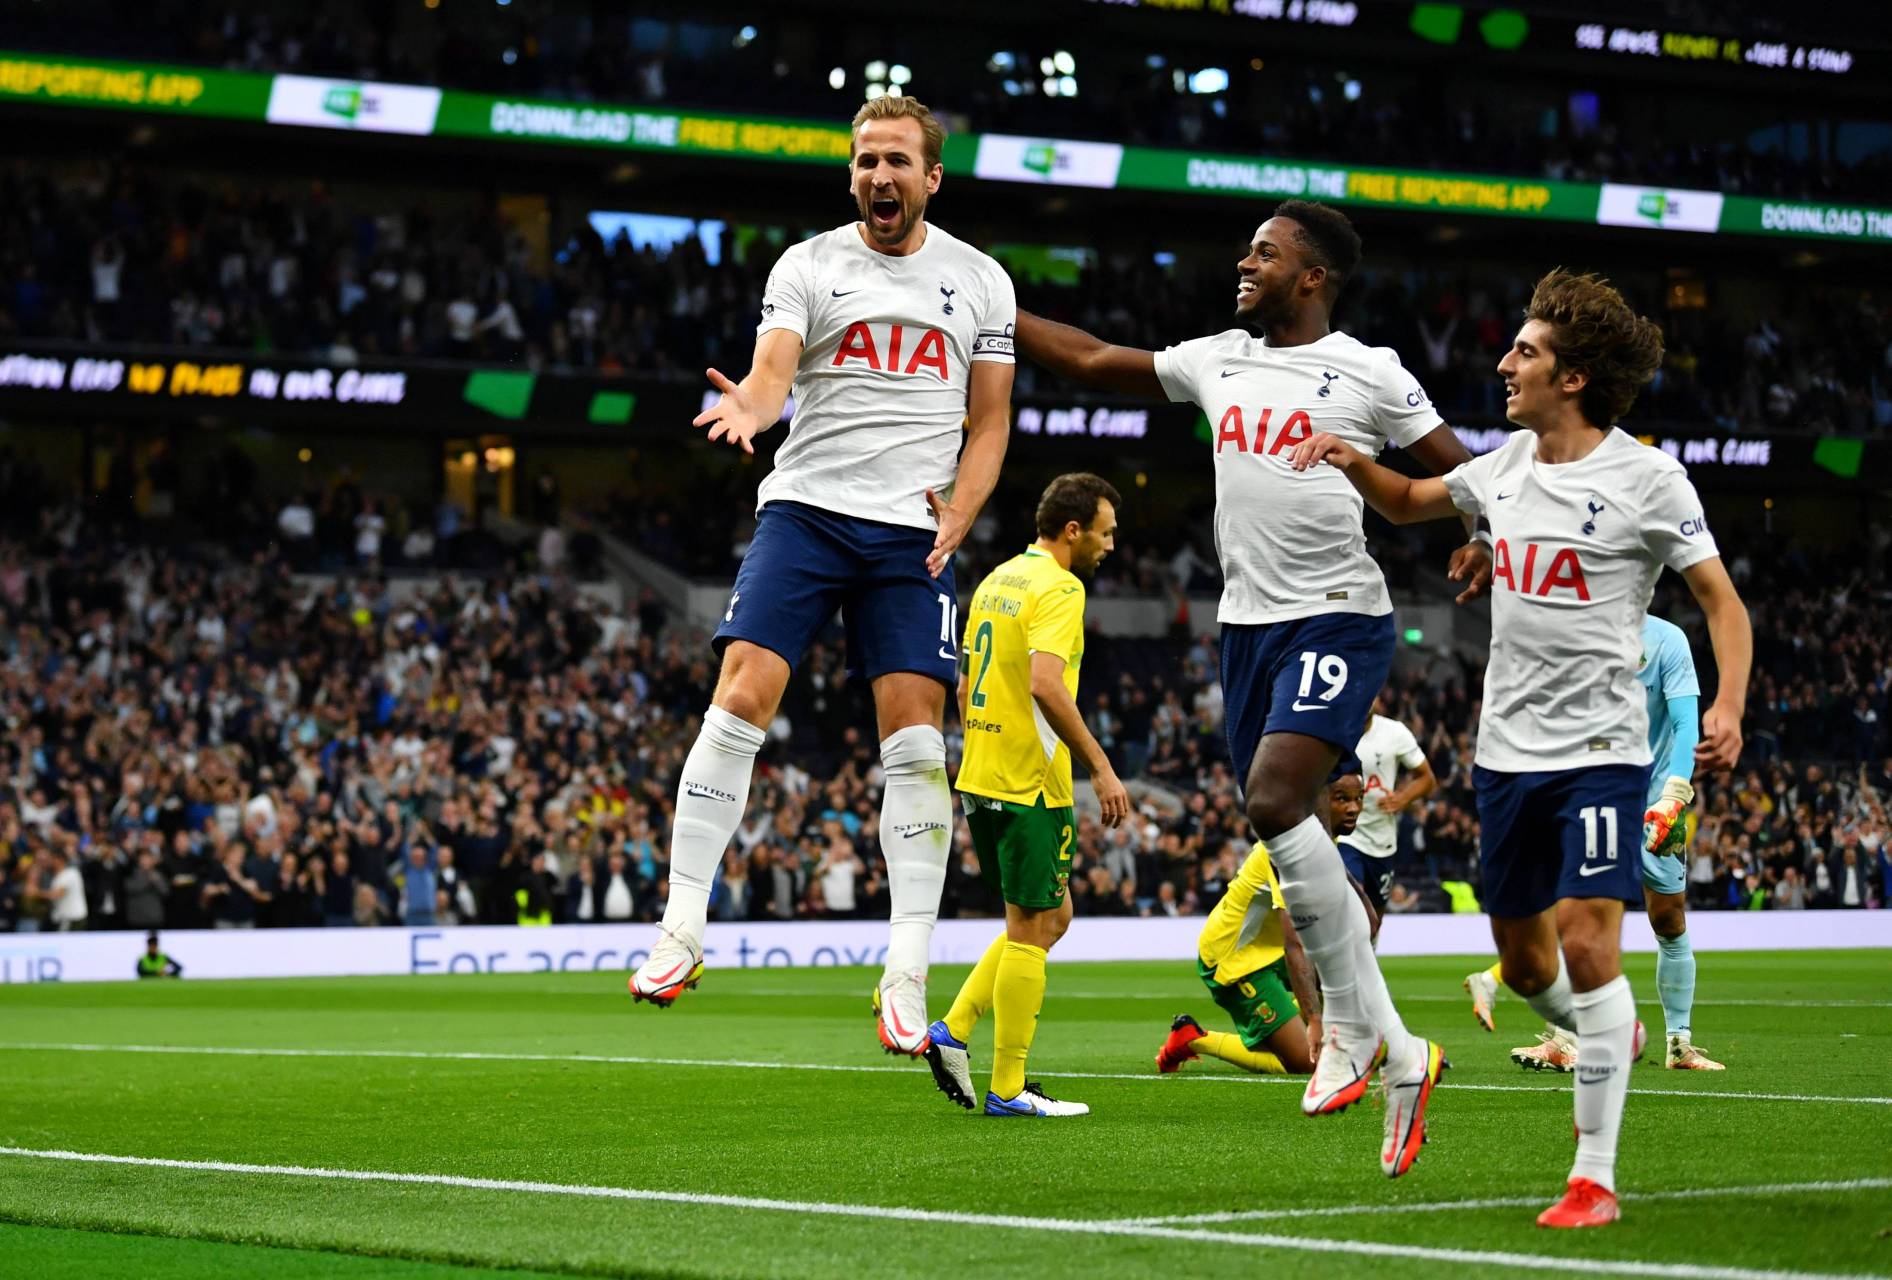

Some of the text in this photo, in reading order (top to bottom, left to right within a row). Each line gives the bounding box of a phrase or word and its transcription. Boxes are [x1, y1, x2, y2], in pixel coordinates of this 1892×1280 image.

[147, 72, 204, 107] APP
[490, 102, 631, 142] DOWNLOAD
[632, 115, 679, 147] THE
[679, 117, 738, 150] FREE
[1187, 159, 1550, 212] DOWNLOAD THE FREE REPORTING APP
[1761, 203, 1864, 237] DOWNLOAD
[832, 320, 949, 381] AIA
[1217, 405, 1314, 456] AIA
[1491, 538, 1591, 602] AIA
[970, 619, 993, 709] 2
[1298, 651, 1348, 702] 19
[685, 780, 737, 802] SPURS
[893, 821, 948, 833] SPURS
[1059, 824, 1073, 861] 2
[1579, 806, 1618, 860] 11
